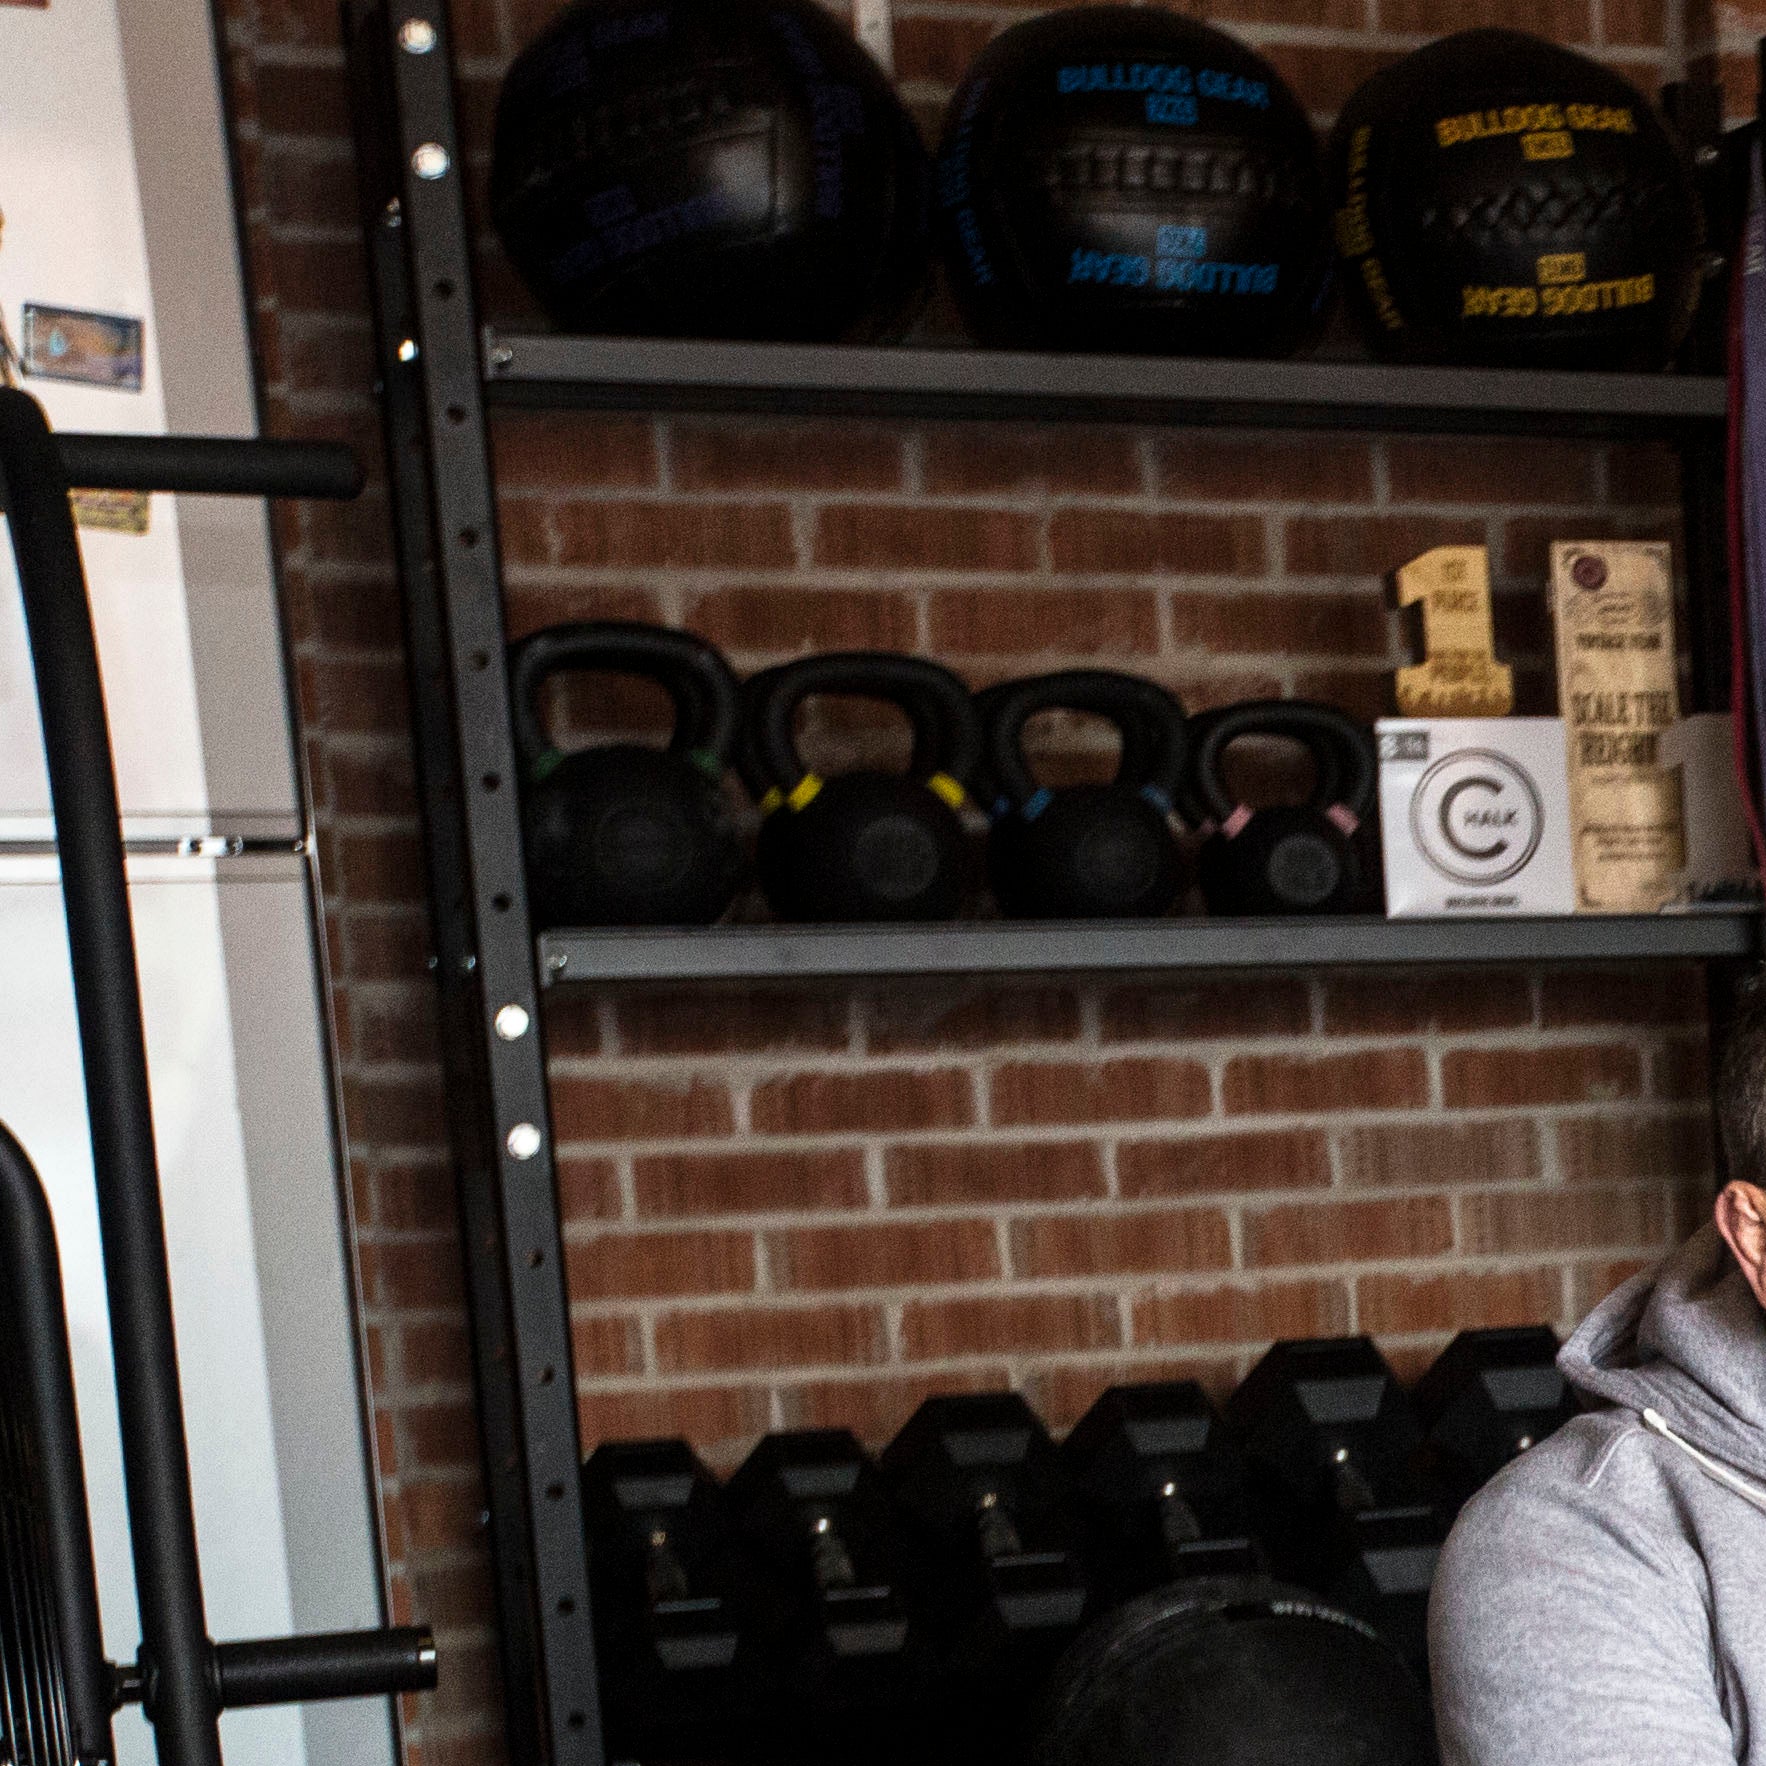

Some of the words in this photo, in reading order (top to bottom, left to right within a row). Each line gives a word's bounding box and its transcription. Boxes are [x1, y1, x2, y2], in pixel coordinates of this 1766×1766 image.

[1056, 63, 1193, 95] BULLDOG
[1196, 68, 1271, 110] GEAR
[1434, 102, 1566, 148] BULLDOG
[1565, 102, 1637, 135] GEAR
